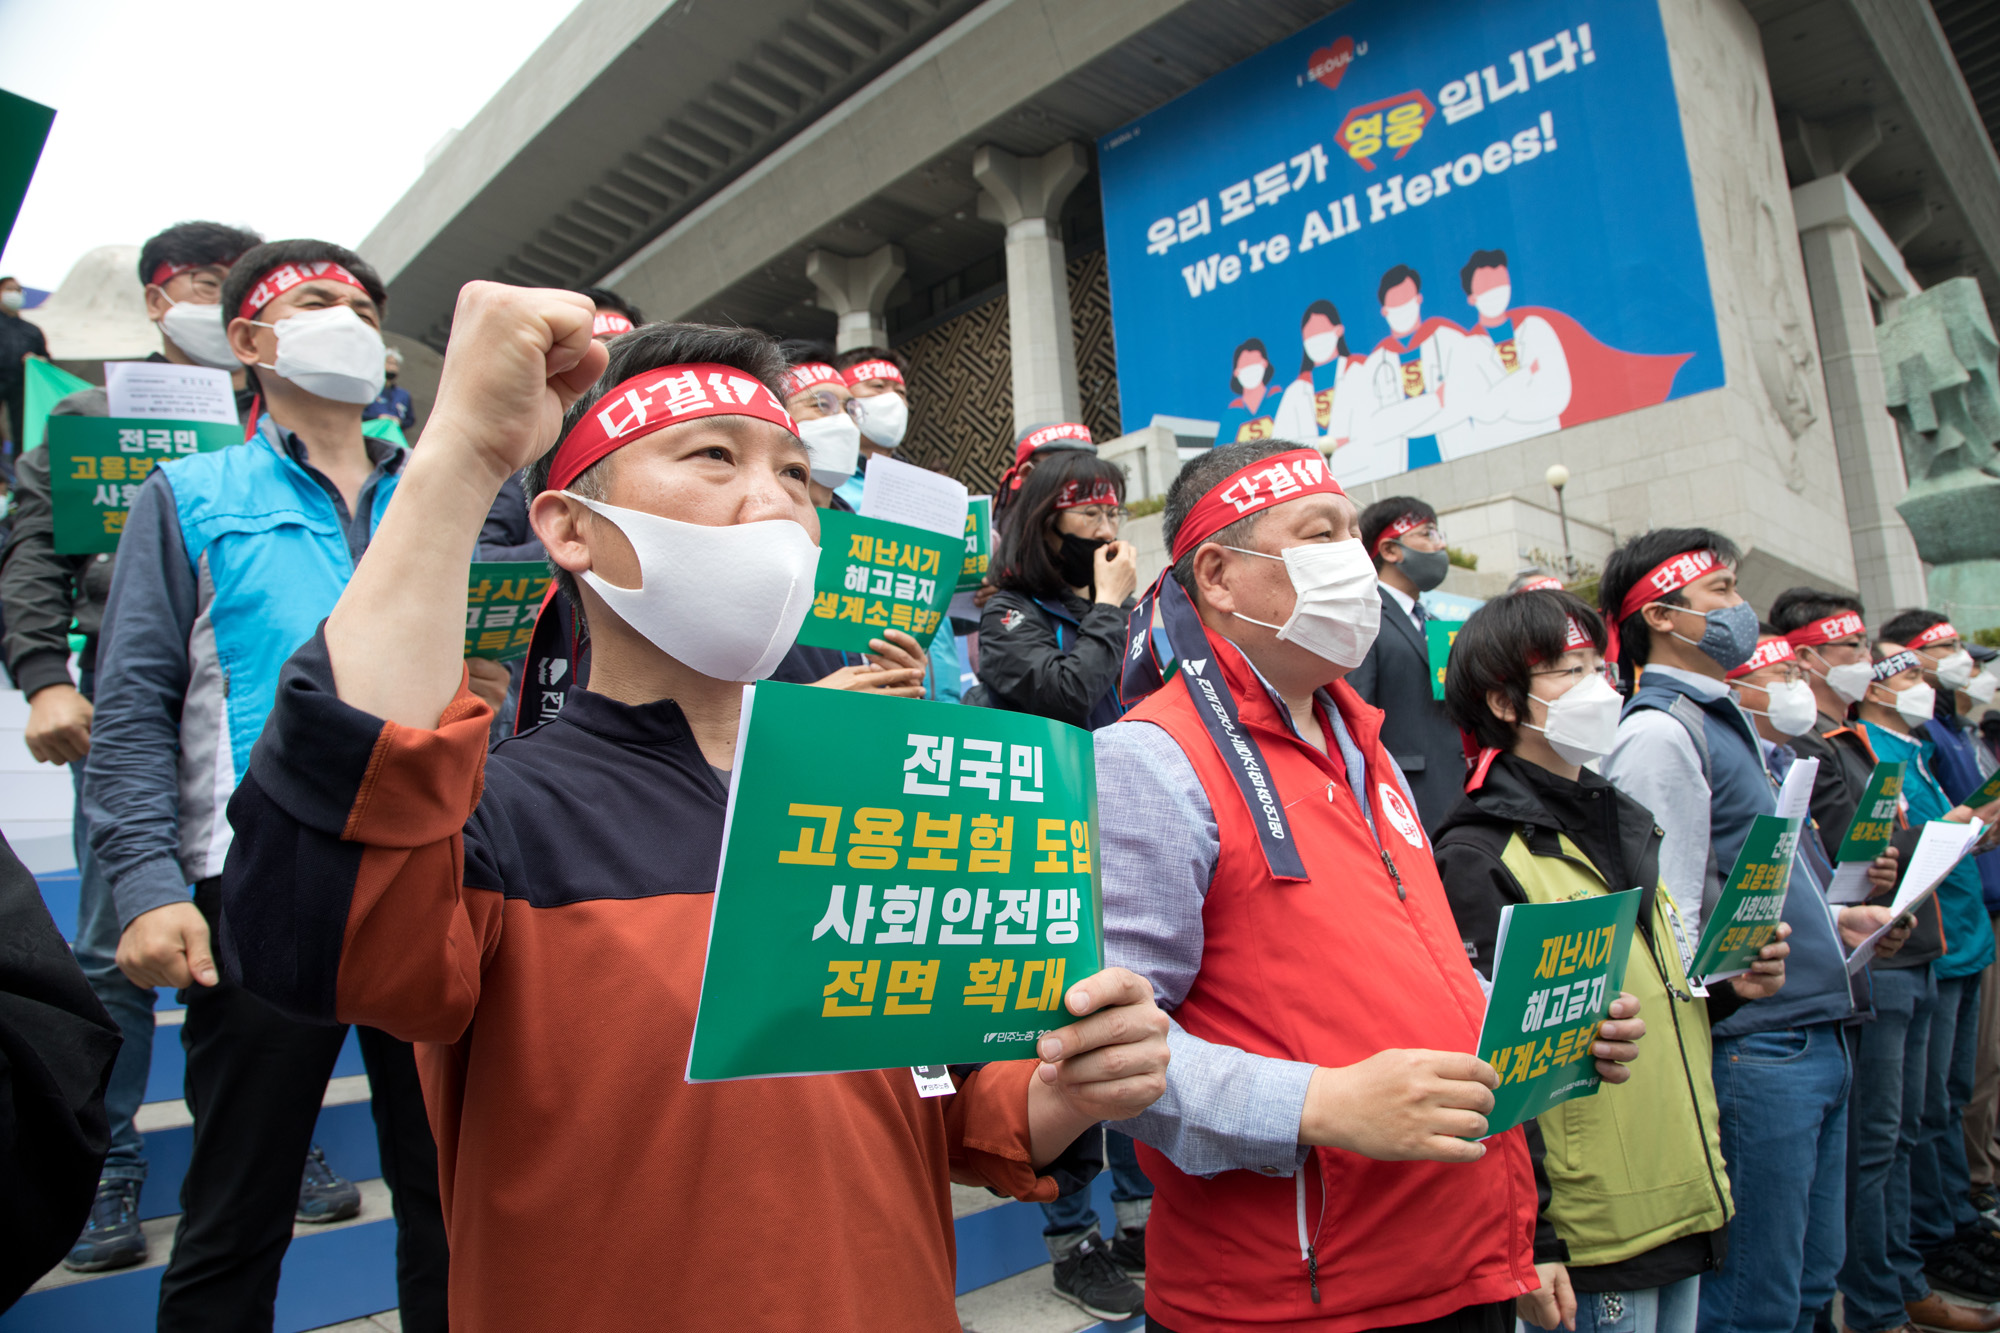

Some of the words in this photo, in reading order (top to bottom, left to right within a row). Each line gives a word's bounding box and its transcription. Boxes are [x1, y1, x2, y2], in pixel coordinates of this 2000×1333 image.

[1307, 52, 1354, 82] SEOUL
[1147, 198, 1211, 255] 우리
[1219, 144, 1329, 226] 모두가
[1345, 103, 1424, 159] 영웅
[1438, 23, 1596, 125] 입니다!
[1182, 234, 1290, 298] We're
[1299, 194, 1361, 253] All
[1366, 111, 1557, 224] Heroes!
[249, 265, 302, 309] 단결
[597, 371, 714, 439] 단결
[118, 429, 198, 453] 전국민
[1219, 461, 1302, 514] 단결
[848, 534, 941, 575] 재난시기
[1650, 554, 1702, 593] 단결
[844, 564, 936, 605] 해고금지
[813, 591, 941, 634] 생계소득보장
[1820, 616, 1854, 640] 단결
[903, 733, 1044, 803] 전국민
[778, 802, 1014, 874] 고용보험
[1034, 818, 1092, 874] 도입
[811, 884, 1081, 945] 사회안전망
[1534, 923, 1617, 979] 재난시기
[821, 959, 940, 1018] 전면
[963, 957, 1066, 1013] 확대
[1521, 973, 1607, 1033] 해고금지
[996, 1030, 1035, 1043] 민주노총
